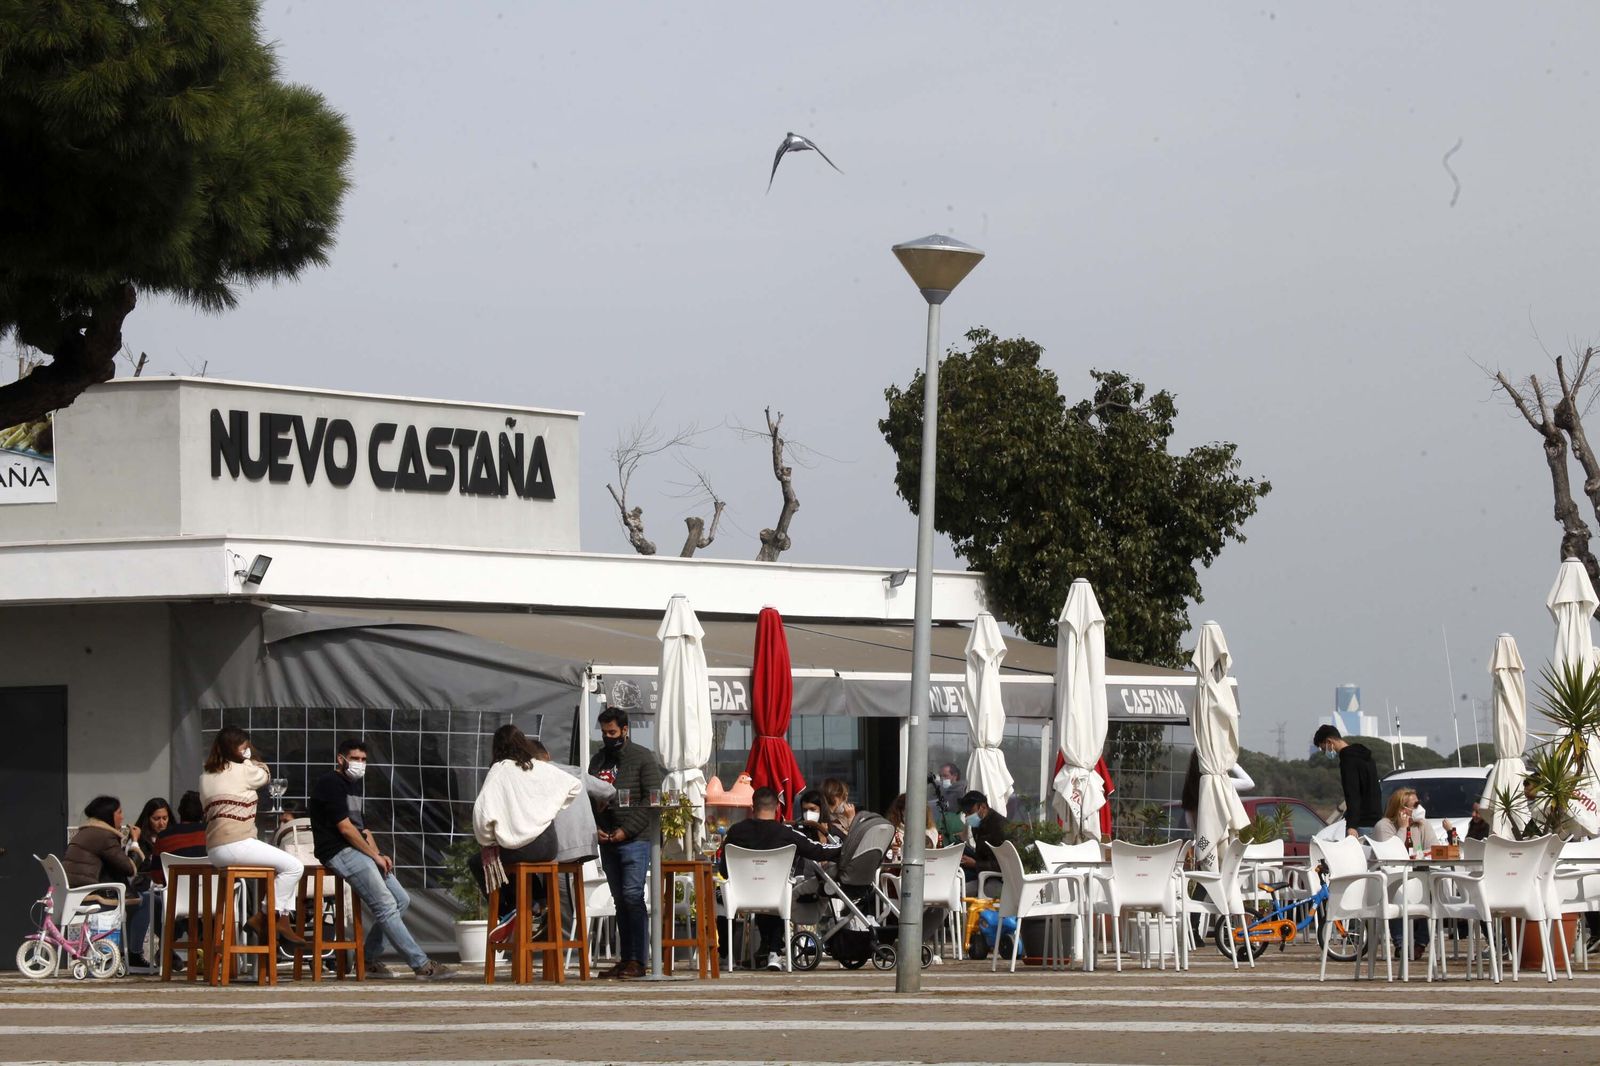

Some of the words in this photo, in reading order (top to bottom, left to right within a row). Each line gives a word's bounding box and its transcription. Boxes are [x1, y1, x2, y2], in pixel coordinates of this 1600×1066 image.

[211, 408, 357, 488] NUEVO
[368, 416, 556, 499] CASTAÑA
[708, 680, 748, 710] BAR
[929, 686, 967, 712] NUEV
[1120, 687, 1187, 715] CASTAÑA
